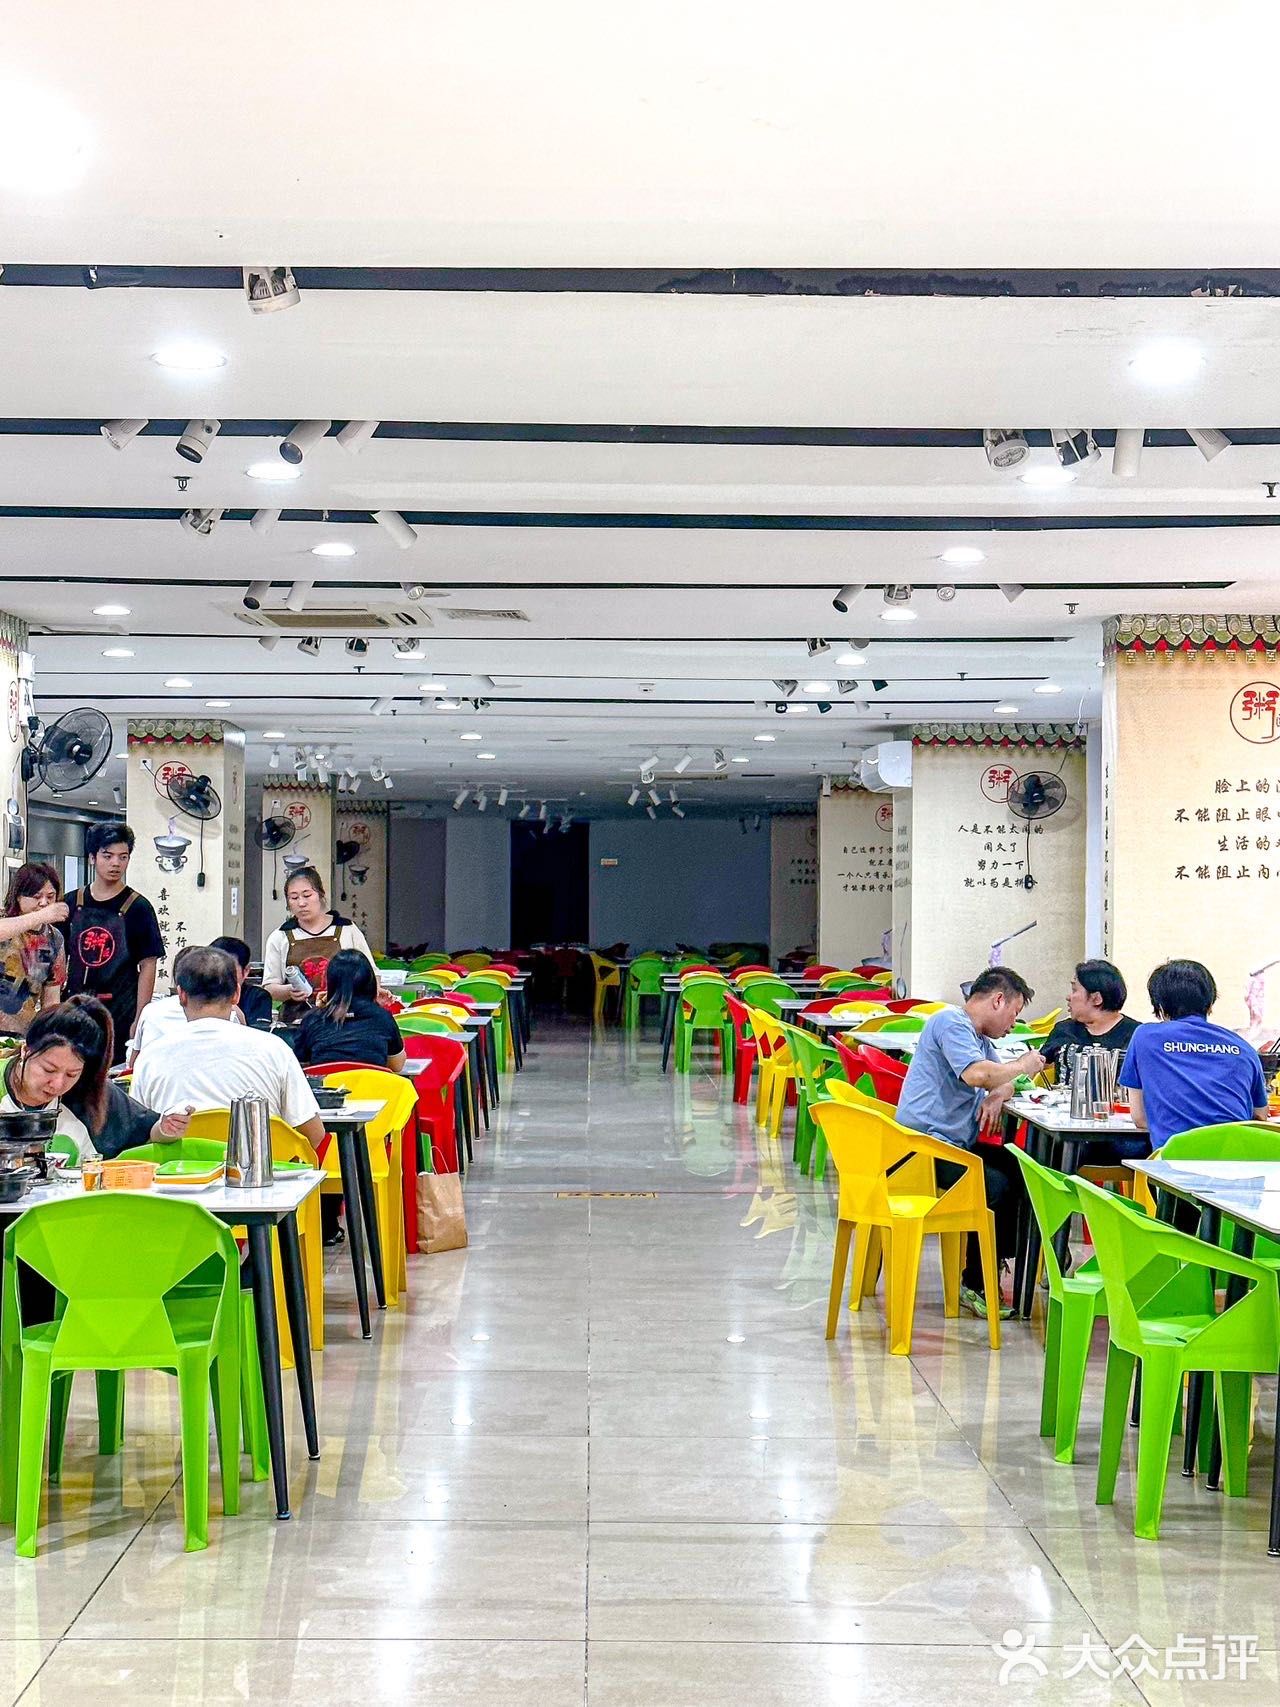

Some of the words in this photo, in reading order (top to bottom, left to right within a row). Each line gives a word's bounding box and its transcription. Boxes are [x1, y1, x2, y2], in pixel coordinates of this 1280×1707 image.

[978, 859, 1025, 870] 努力一下
[837, 871, 893, 879] 一个人只有承
[1174, 864, 1280, 880] 不能阻止内
[175, 921, 187, 948] 不行
[1163, 1041, 1240, 1055] SHUNCHANG
